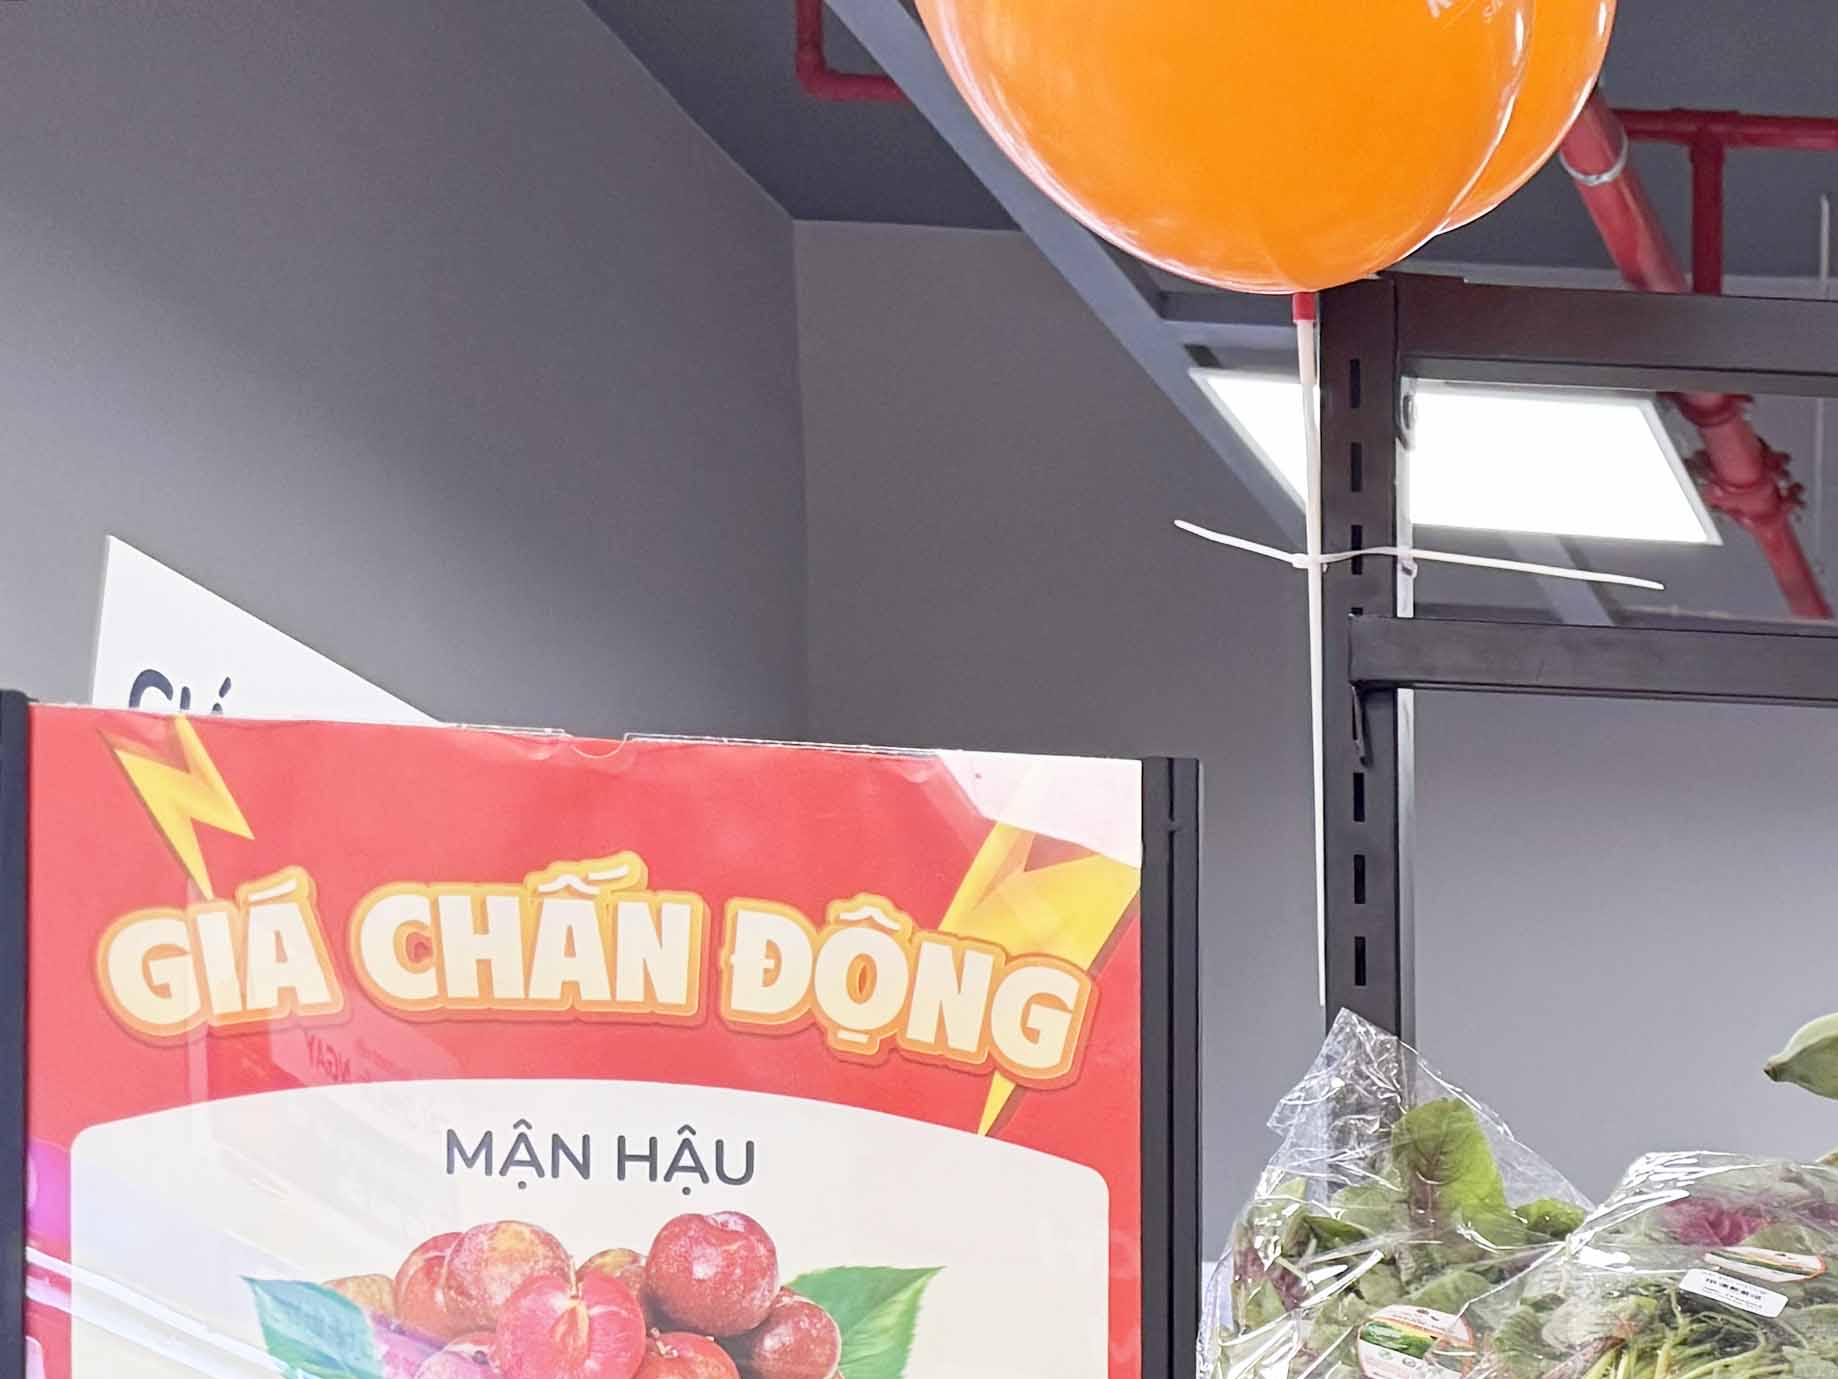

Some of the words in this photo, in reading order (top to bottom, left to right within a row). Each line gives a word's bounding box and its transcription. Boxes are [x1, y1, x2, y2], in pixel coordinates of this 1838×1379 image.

[103, 872, 338, 1030] GIÁ
[360, 862, 695, 1010] CHẤN
[730, 905, 1085, 1074] ĐỘNG
[446, 1120, 592, 1196] MẬN
[614, 1122, 758, 1199] HẬU
